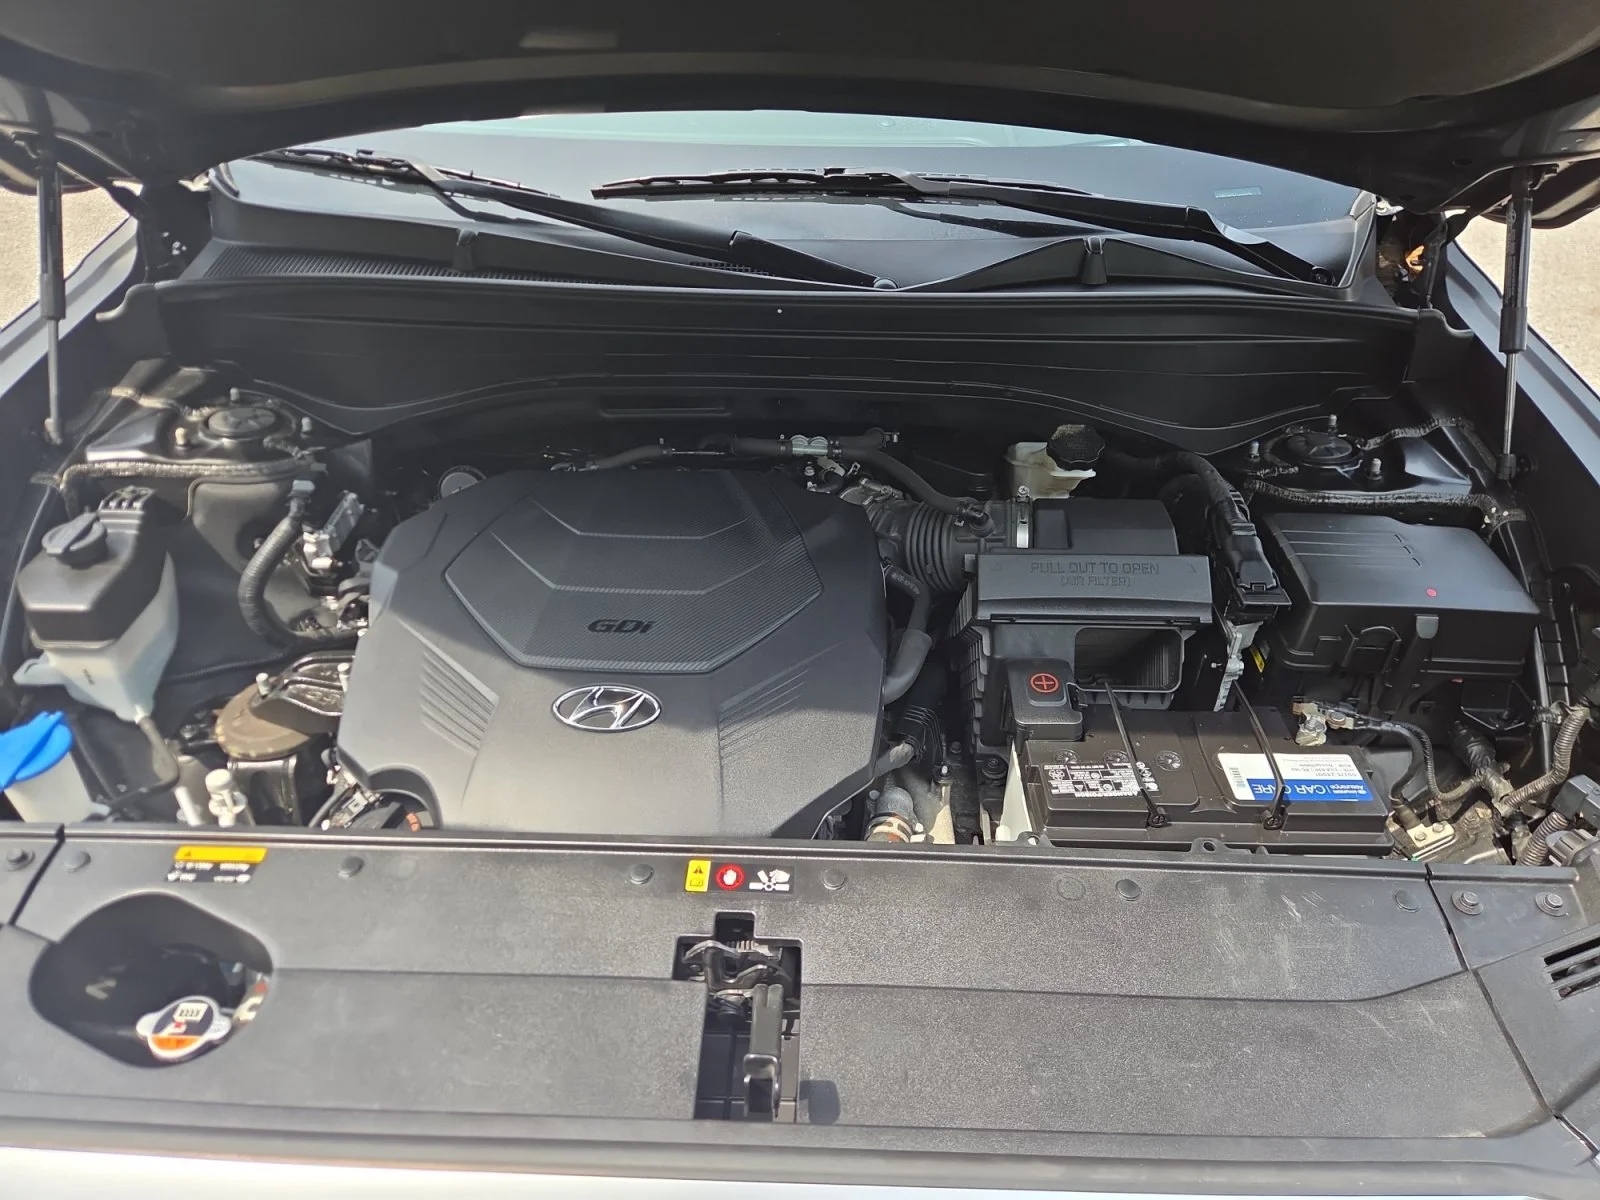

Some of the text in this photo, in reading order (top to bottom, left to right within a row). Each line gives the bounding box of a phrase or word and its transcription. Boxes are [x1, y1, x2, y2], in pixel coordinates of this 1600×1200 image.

[1030, 562, 1160, 575] PULL OUT TO OPEN
[1060, 576, 1131, 588] (AIR FILTER)
[587, 619, 656, 633] GDi
[1295, 784, 1326, 794] CAR
